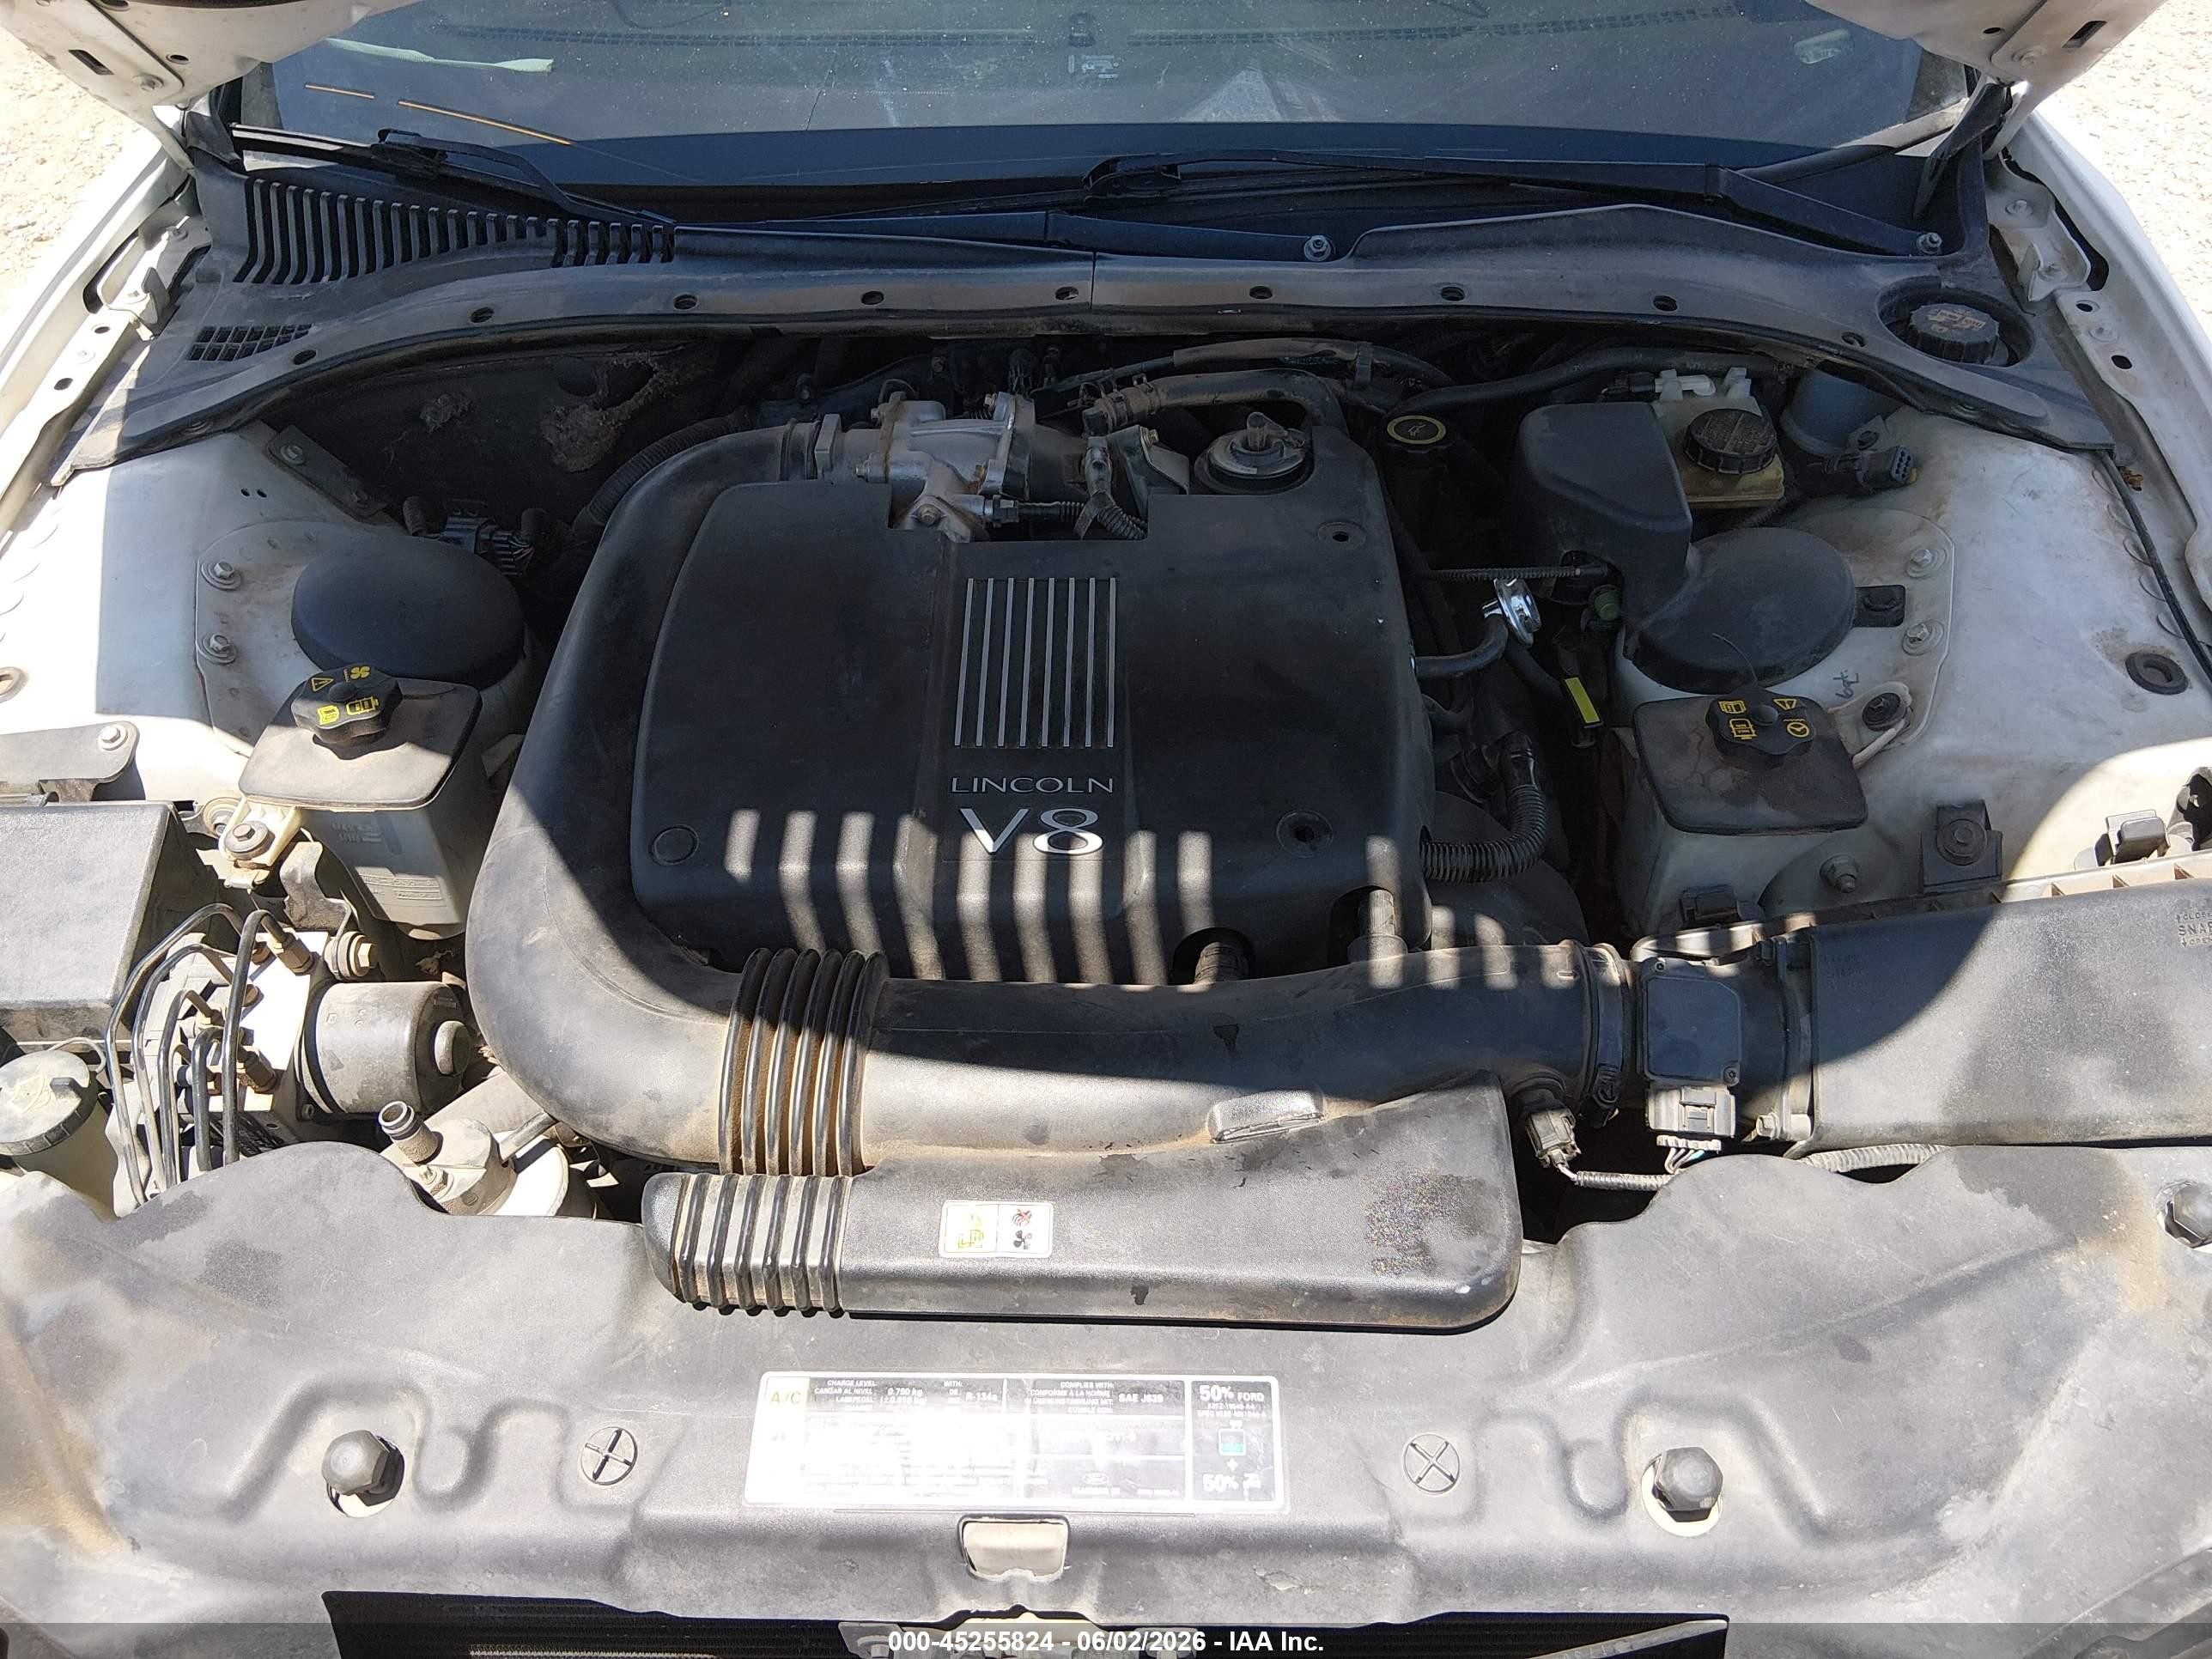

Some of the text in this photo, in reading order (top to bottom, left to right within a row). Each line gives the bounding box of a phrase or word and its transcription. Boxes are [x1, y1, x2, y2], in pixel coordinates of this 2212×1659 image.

[951, 777, 1114, 793] LINCOLN
[959, 807, 1104, 855] V8
[1118, 1393, 1139, 1402] SAE
[1199, 1384, 1265, 1401] 50% FORD
[1202, 1474, 1239, 1492] 50%
